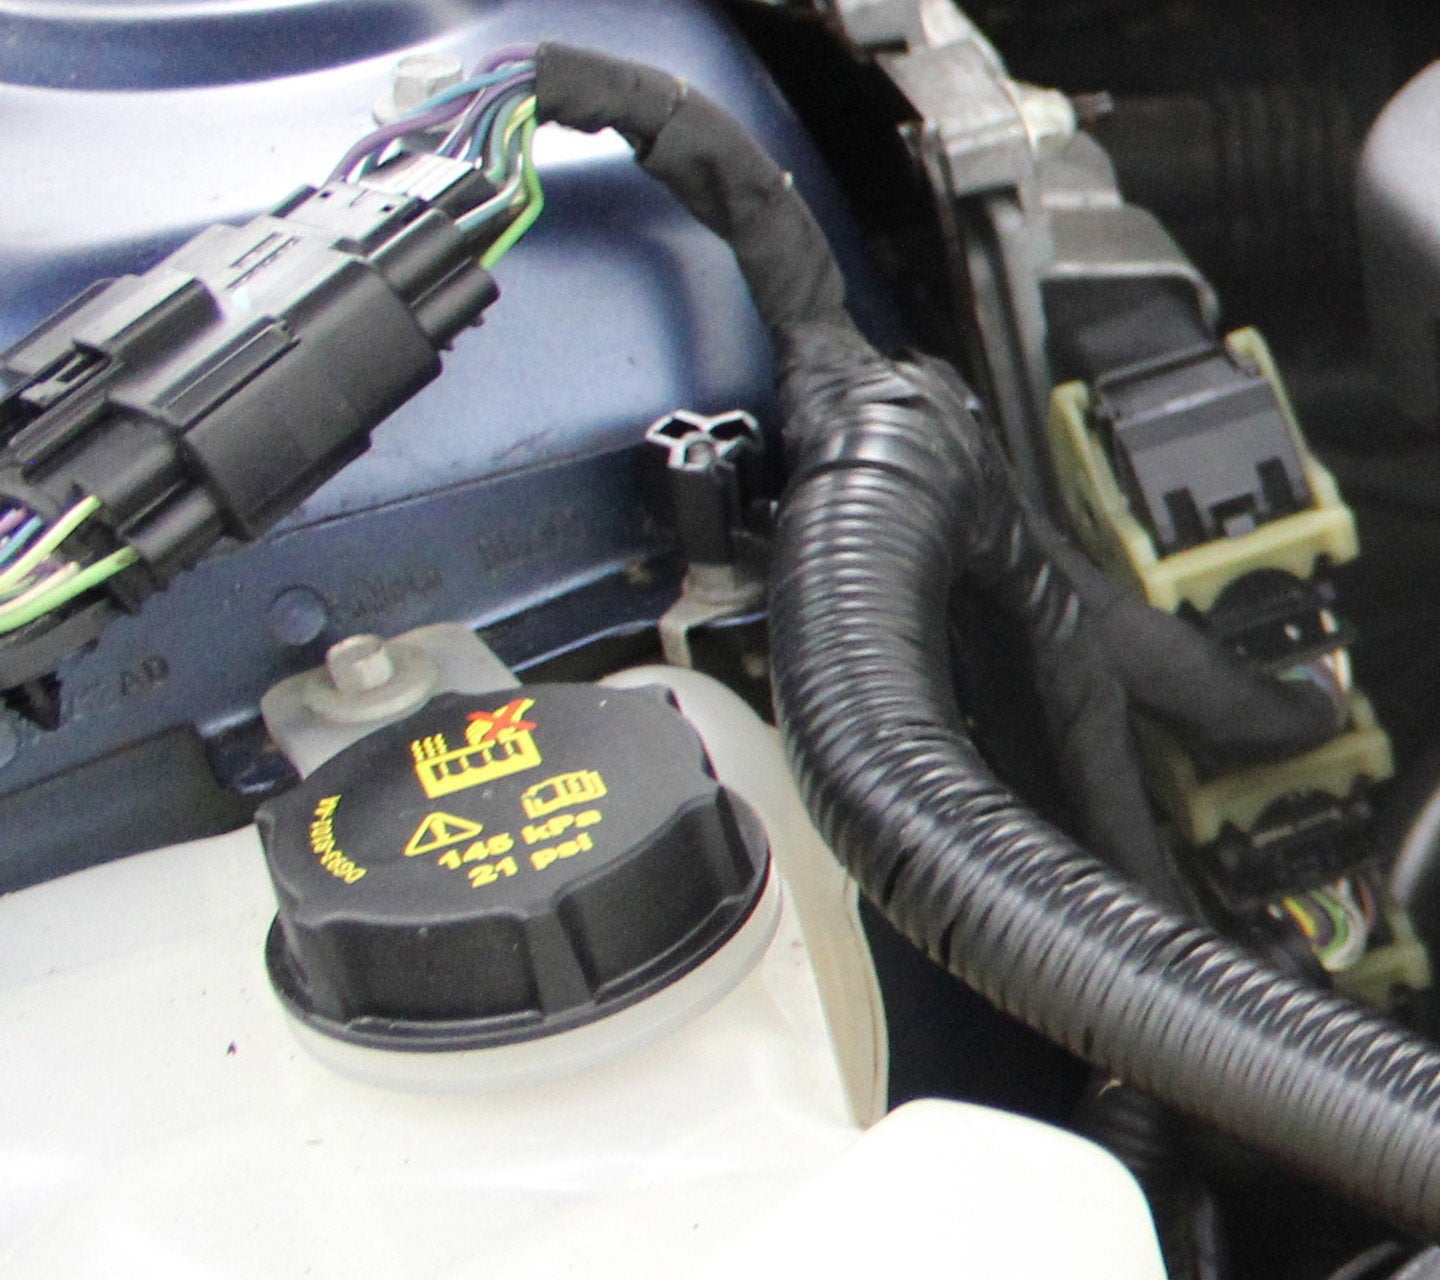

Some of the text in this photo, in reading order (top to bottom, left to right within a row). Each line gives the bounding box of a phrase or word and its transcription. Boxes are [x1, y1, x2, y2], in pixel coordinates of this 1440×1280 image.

[438, 809, 602, 870] 145 kPa
[467, 832, 594, 888] 21 psi
